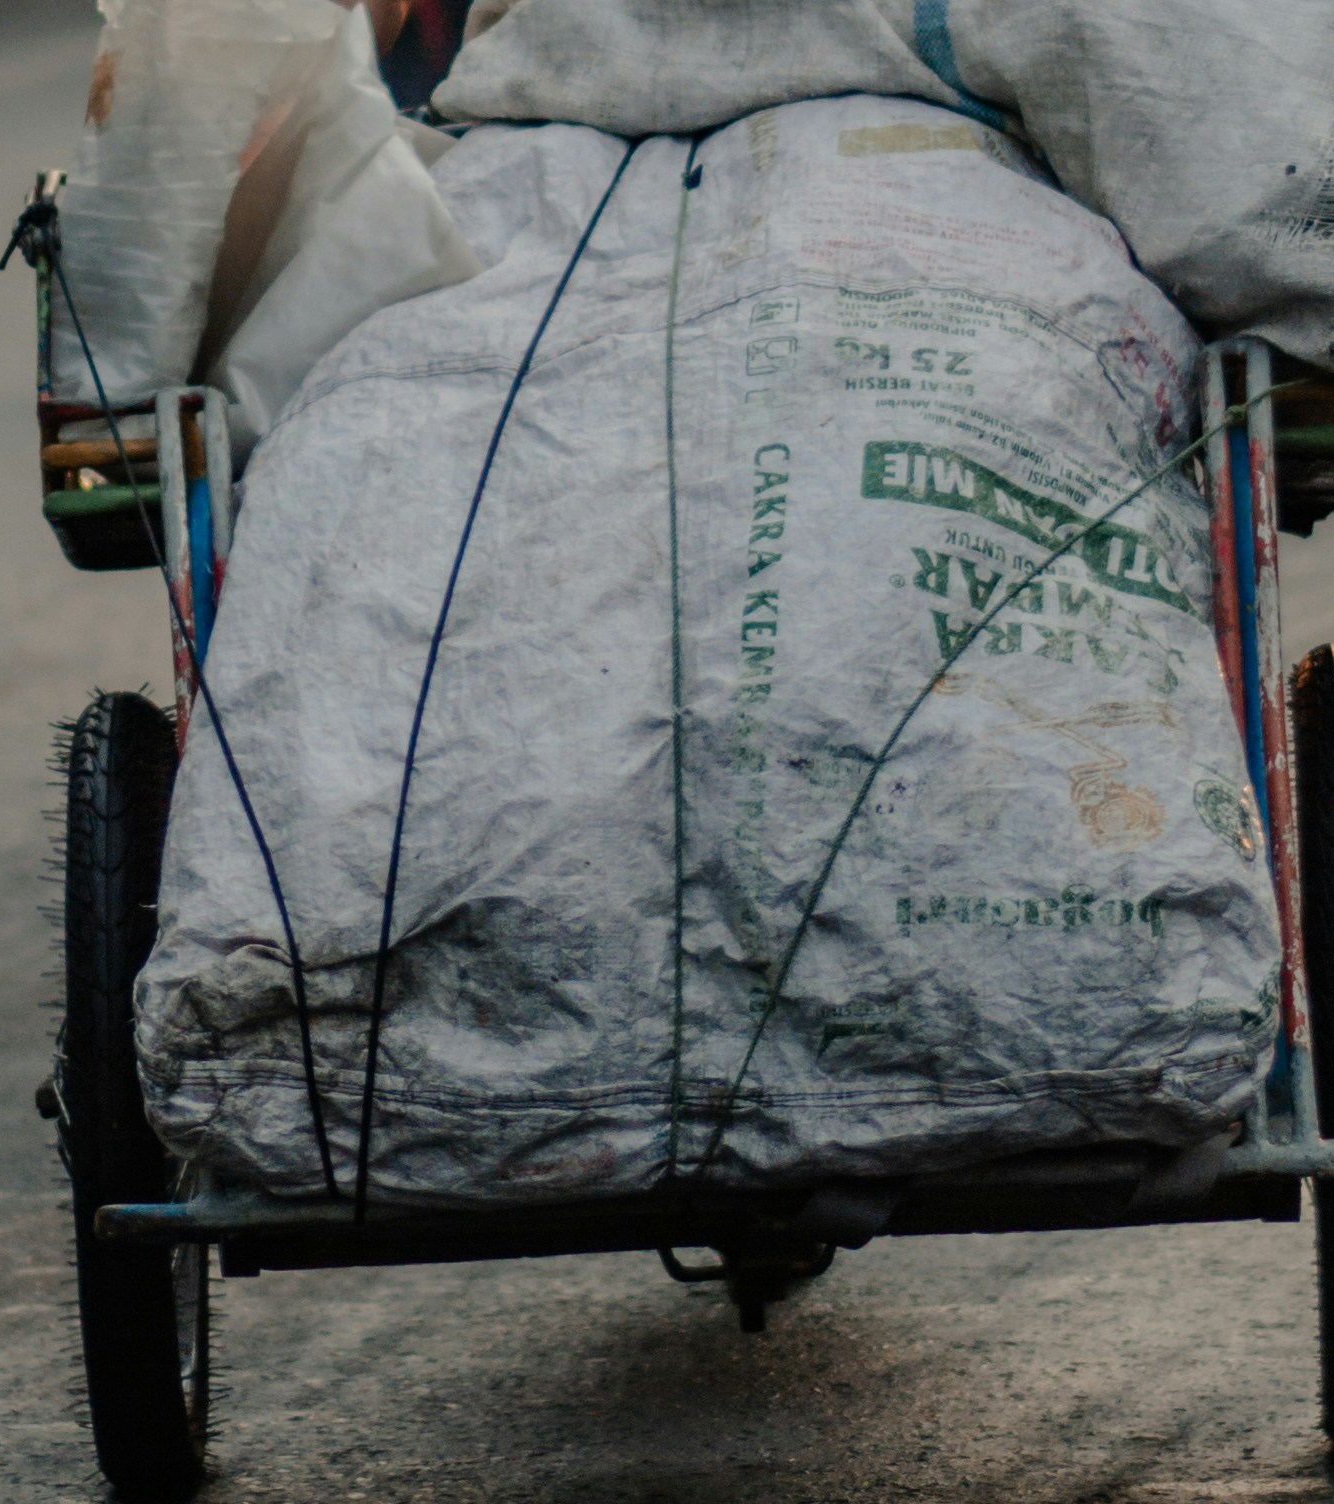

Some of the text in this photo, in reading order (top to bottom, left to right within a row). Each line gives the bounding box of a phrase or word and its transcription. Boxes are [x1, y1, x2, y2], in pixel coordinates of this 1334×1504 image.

[844, 376, 912, 392] BERSIH
[911, 347, 974, 377] 25
[882, 451, 975, 500] MIE
[747, 442, 791, 579] CAKRA
[944, 528, 1007, 564] UNTUK
[1106, 535, 1182, 594] OTI
[895, 882, 1165, 939] bogasari
